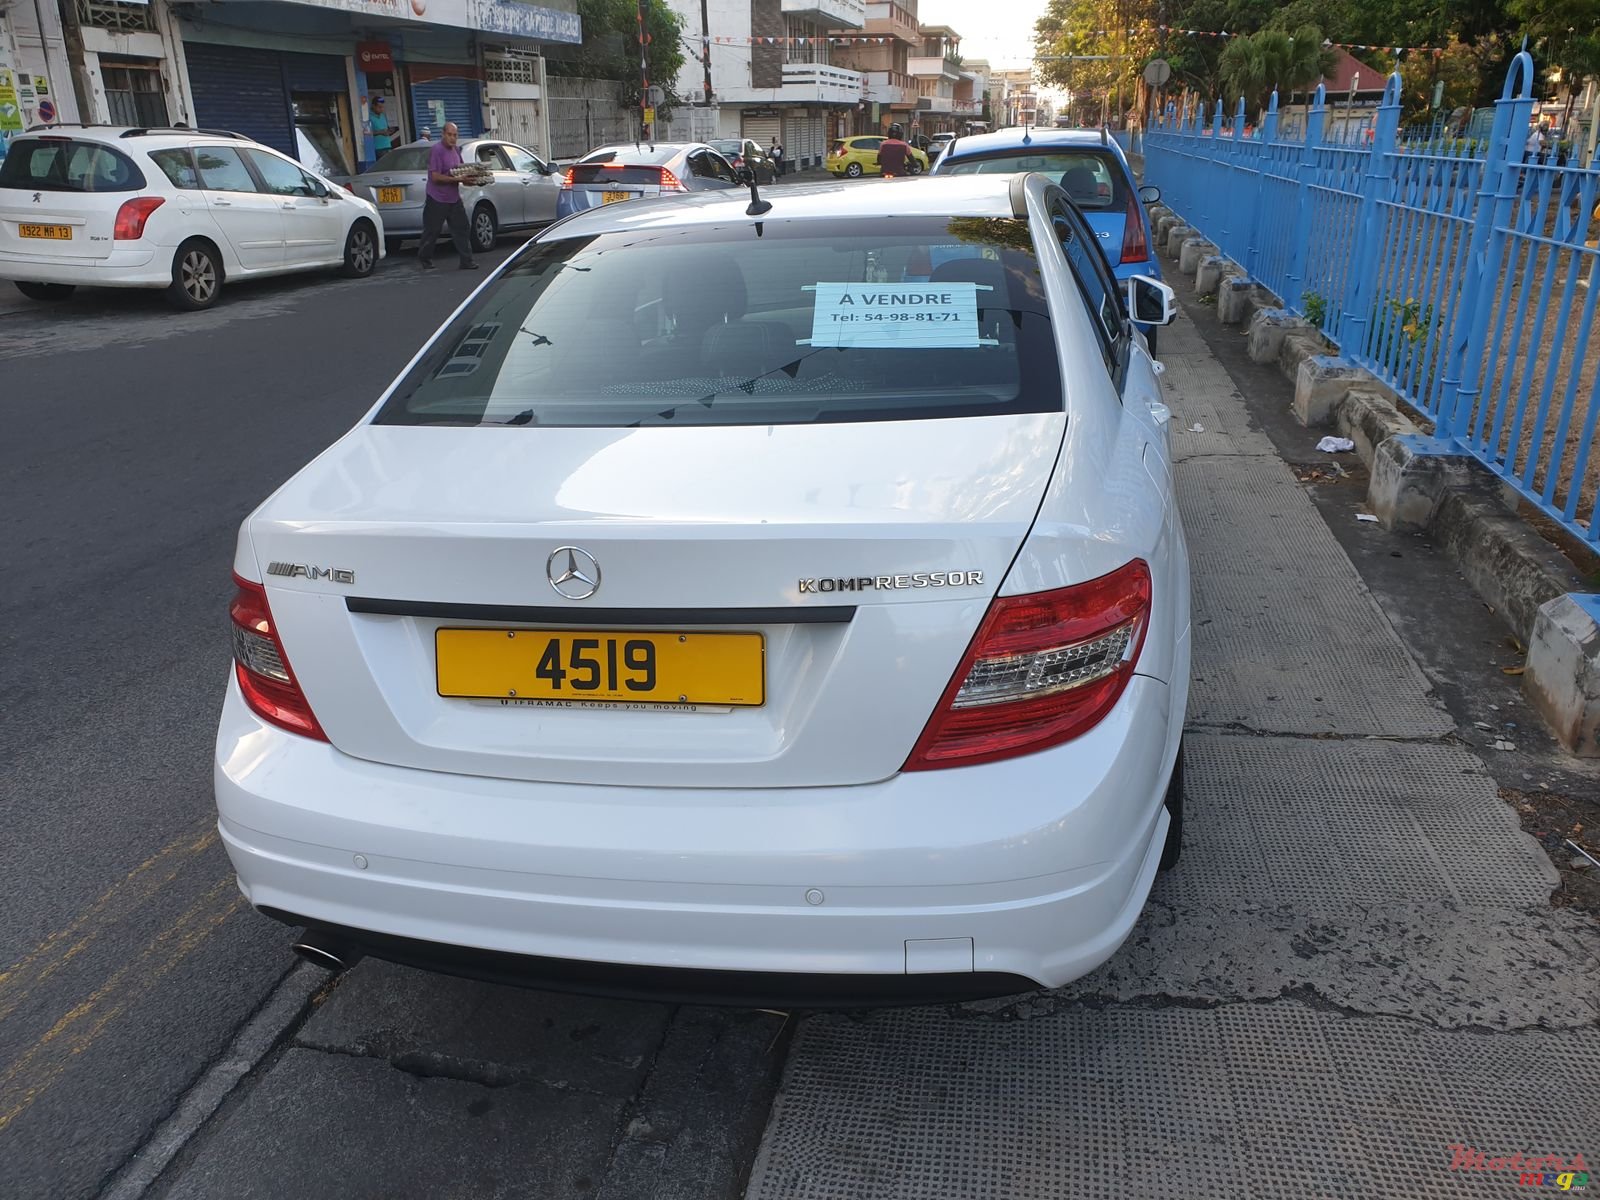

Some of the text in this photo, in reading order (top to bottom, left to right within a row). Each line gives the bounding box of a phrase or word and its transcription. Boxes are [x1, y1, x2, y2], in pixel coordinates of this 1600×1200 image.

[22, 225, 41, 236] 1922
[59, 227, 69, 238] 13
[839, 293, 953, 306] A VENDRE
[830, 312, 960, 322] Tel: 54-98-81-71
[290, 563, 354, 584] AMG
[799, 570, 985, 593] KOMPRESSOR
[535, 638, 656, 692] 4519
